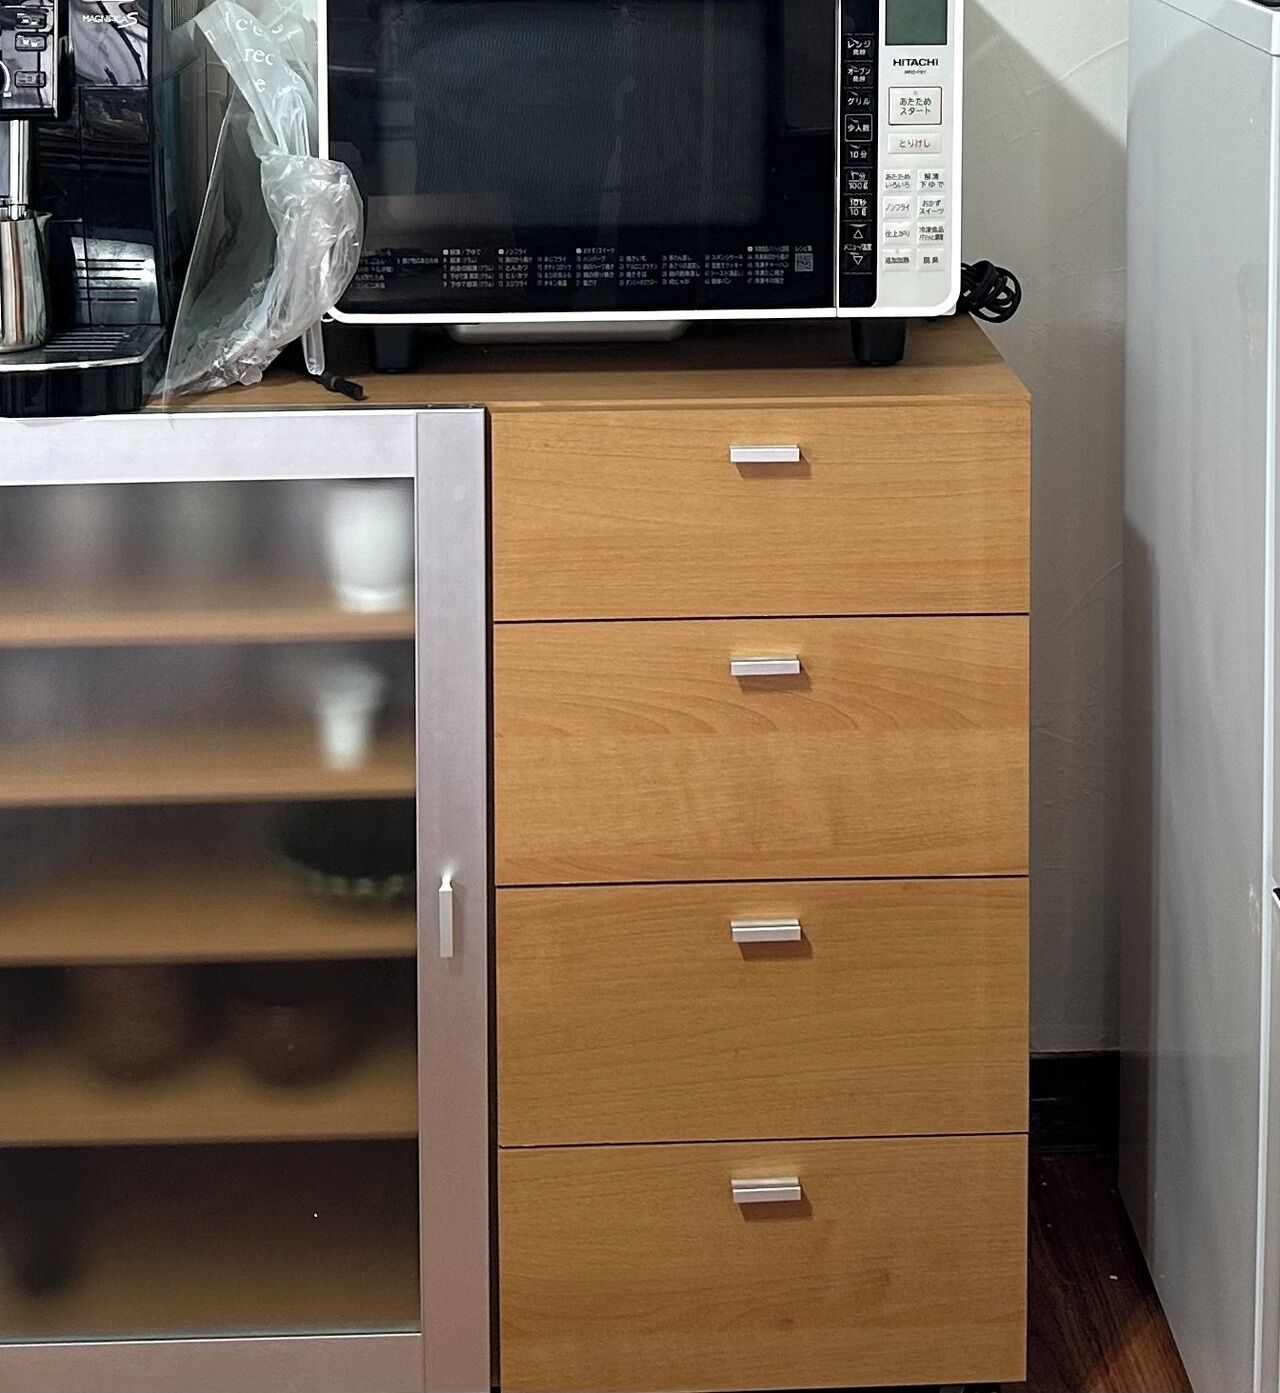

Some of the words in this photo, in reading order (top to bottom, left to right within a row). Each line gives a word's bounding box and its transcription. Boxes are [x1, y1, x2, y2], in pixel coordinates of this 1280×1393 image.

[892, 58, 939, 67] HITACHI
[847, 97, 871, 106] グリル
[899, 97, 932, 107] あたため
[899, 108, 931, 116] スタート
[899, 139, 931, 149] とりけし
[885, 173, 911, 181] あたため
[920, 181, 944, 189] 下ゆで
